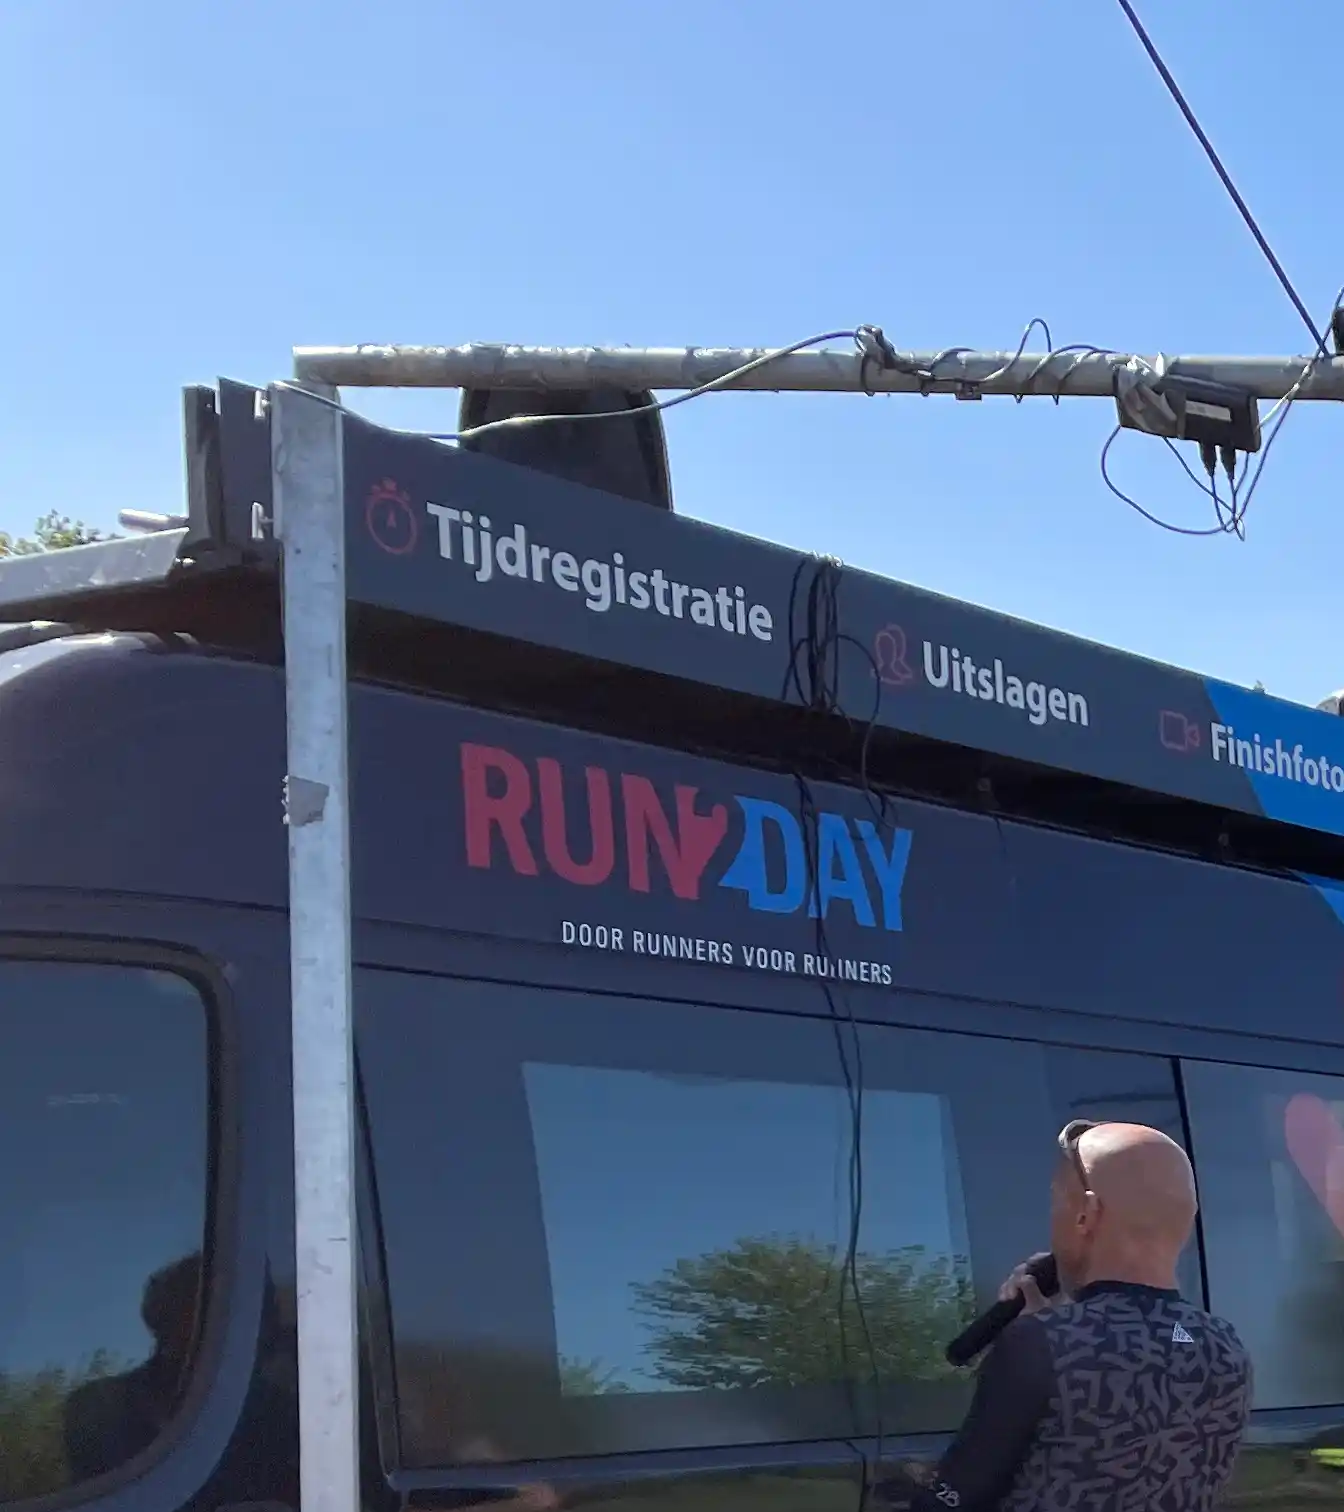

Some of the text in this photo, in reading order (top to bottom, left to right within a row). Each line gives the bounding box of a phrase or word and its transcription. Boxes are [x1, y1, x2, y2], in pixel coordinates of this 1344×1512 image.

[425, 501, 774, 642] Tijdregistratie
[922, 641, 1090, 727] Uitslagen
[562, 920, 624, 951] DOOR
[633, 931, 734, 965] RUNNERS
[742, 946, 796, 973] VOOR
